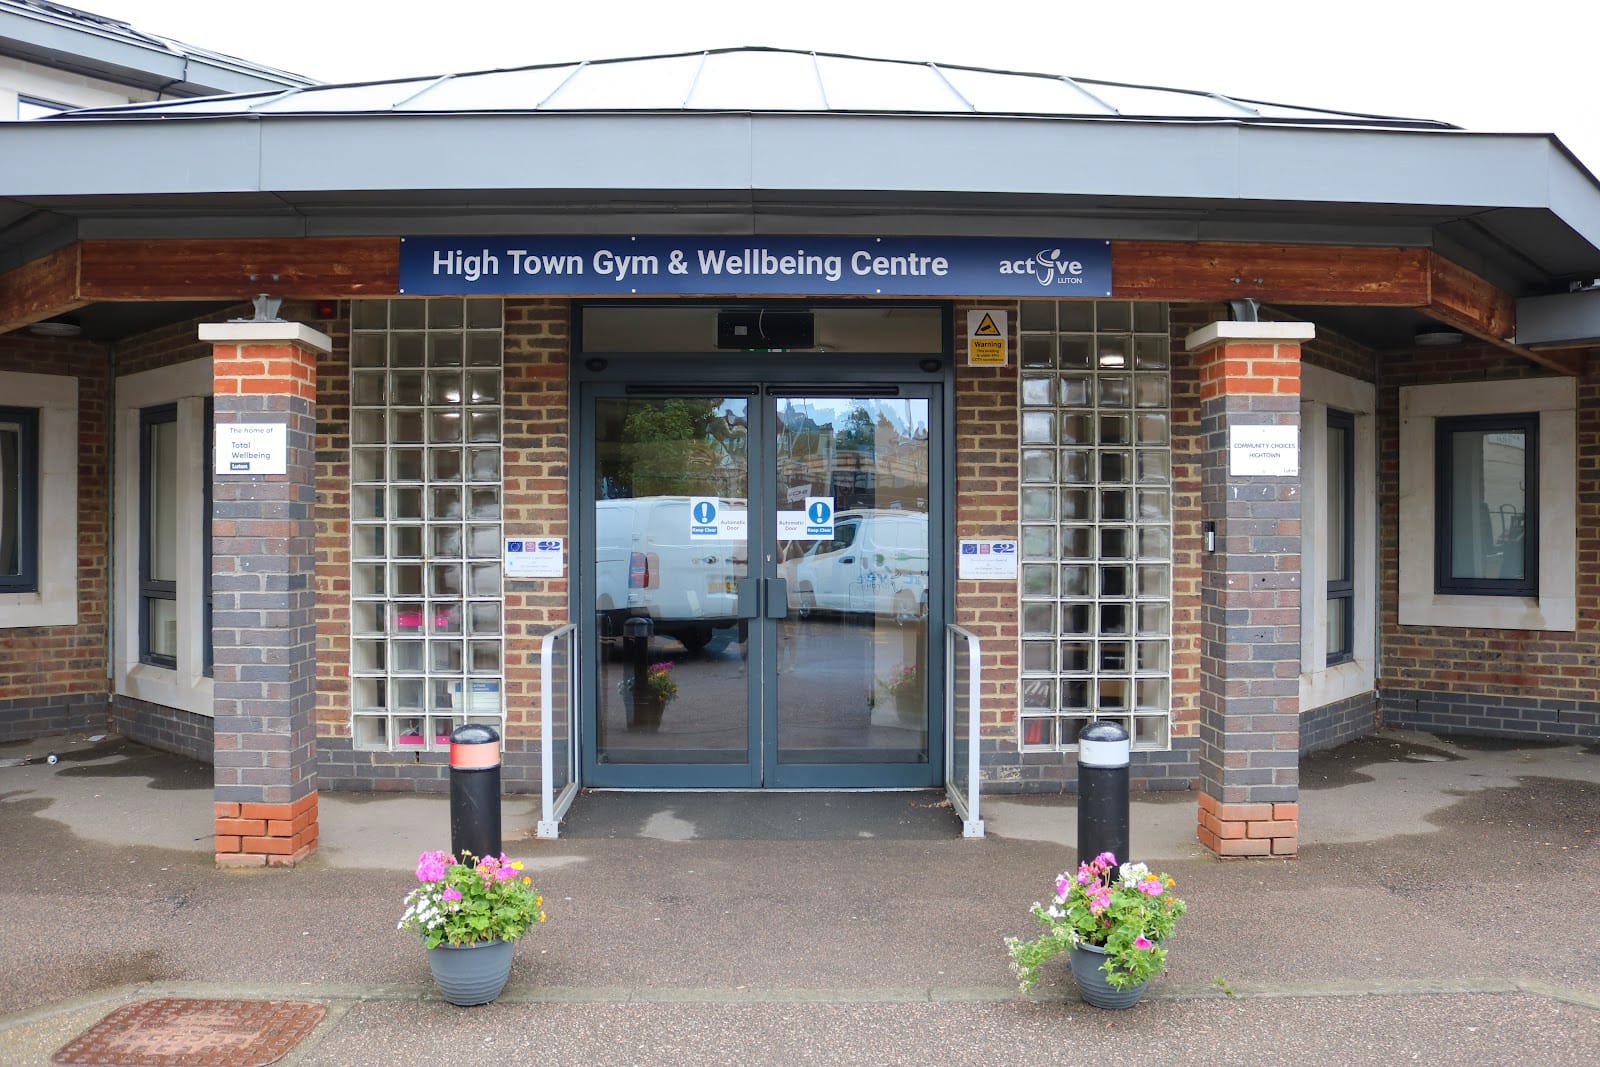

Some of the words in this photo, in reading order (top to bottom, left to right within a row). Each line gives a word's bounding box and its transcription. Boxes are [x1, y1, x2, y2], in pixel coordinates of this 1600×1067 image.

[432, 249, 499, 281] High
[506, 249, 584, 275] Town
[592, 249, 659, 281] Gym
[667, 249, 689, 275] &
[697, 248, 842, 281] Wellbeing
[851, 250, 949, 276] Centre
[231, 452, 271, 460] Wellbeing
